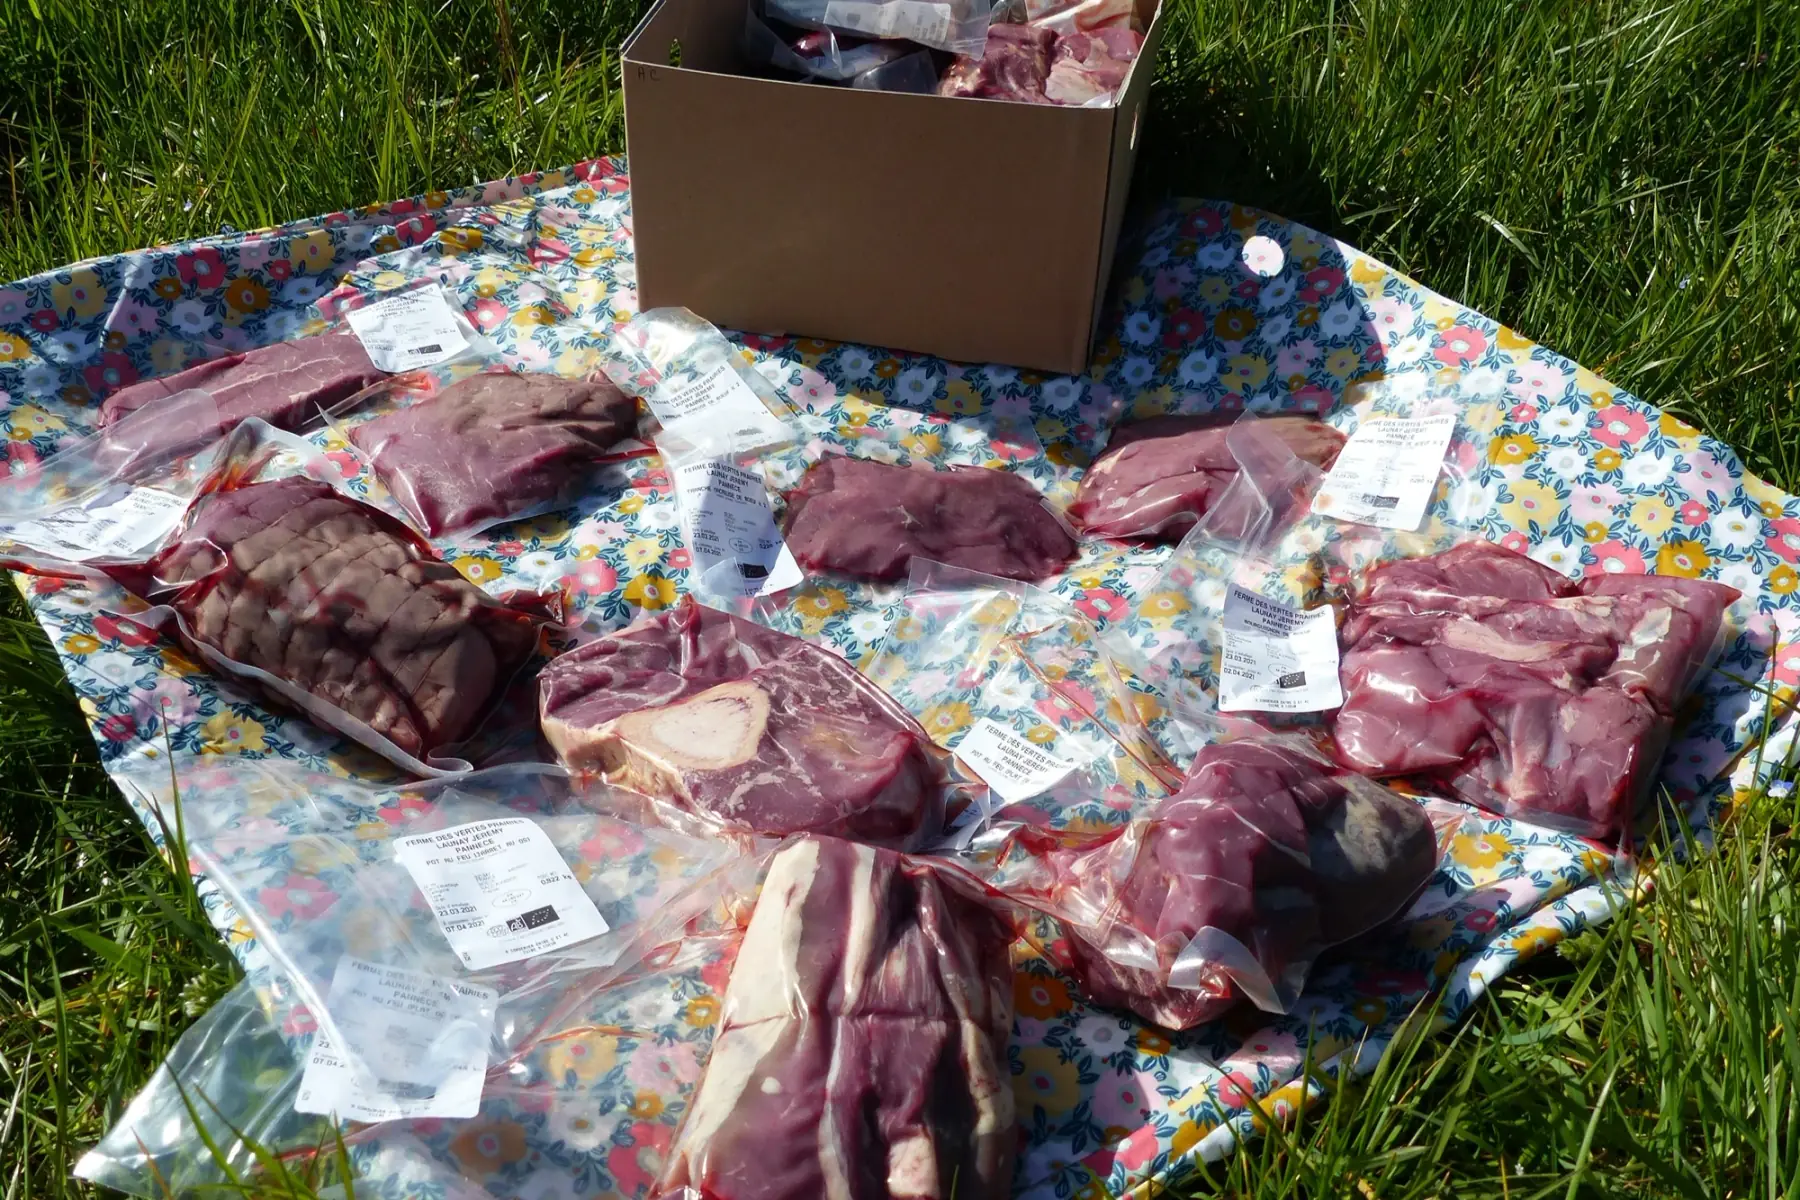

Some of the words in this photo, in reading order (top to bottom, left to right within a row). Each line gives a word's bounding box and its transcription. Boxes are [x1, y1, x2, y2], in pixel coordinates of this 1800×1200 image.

[683, 384, 704, 397] VERTES
[684, 463, 707, 474] FERME
[707, 462, 721, 470] DES
[721, 464, 740, 476] VERTES
[706, 470, 728, 480] LAUNAY
[1234, 590, 1254, 604] FERME
[1255, 600, 1268, 609] DES
[1269, 605, 1293, 618] VERTES
[1251, 606, 1277, 620] LAUNAY
[1277, 616, 1305, 625] JEREMY
[1262, 618, 1293, 631] PANNECE
[1225, 653, 1257, 665] 23.03.2021
[1223, 668, 1255, 680] 02.04.2021
[985, 725, 1008, 741] FERME
[1007, 737, 1021, 749] DES
[1020, 745, 1047, 763] VERTES
[997, 743, 1024, 760] LAUNAY
[970, 749, 983, 758] POT
[992, 761, 1005, 771] FEU
[1001, 756, 1032, 775] PANNECE
[406, 837, 435, 848] FERME
[435, 833, 454, 843] DES
[455, 824, 488, 838] VERTES
[488, 819, 525, 829] PRAIRIES
[436, 837, 470, 850] LAUNAY
[471, 828, 504, 842] JEREMY
[455, 838, 496, 853] PANNECE
[426, 858, 440, 866] POT
[456, 853, 472, 862] FEU
[439, 905, 478, 917] 23.03.2021
[445, 920, 486, 933] 07.04.2021
[379, 980, 416, 993] LAUNAY
